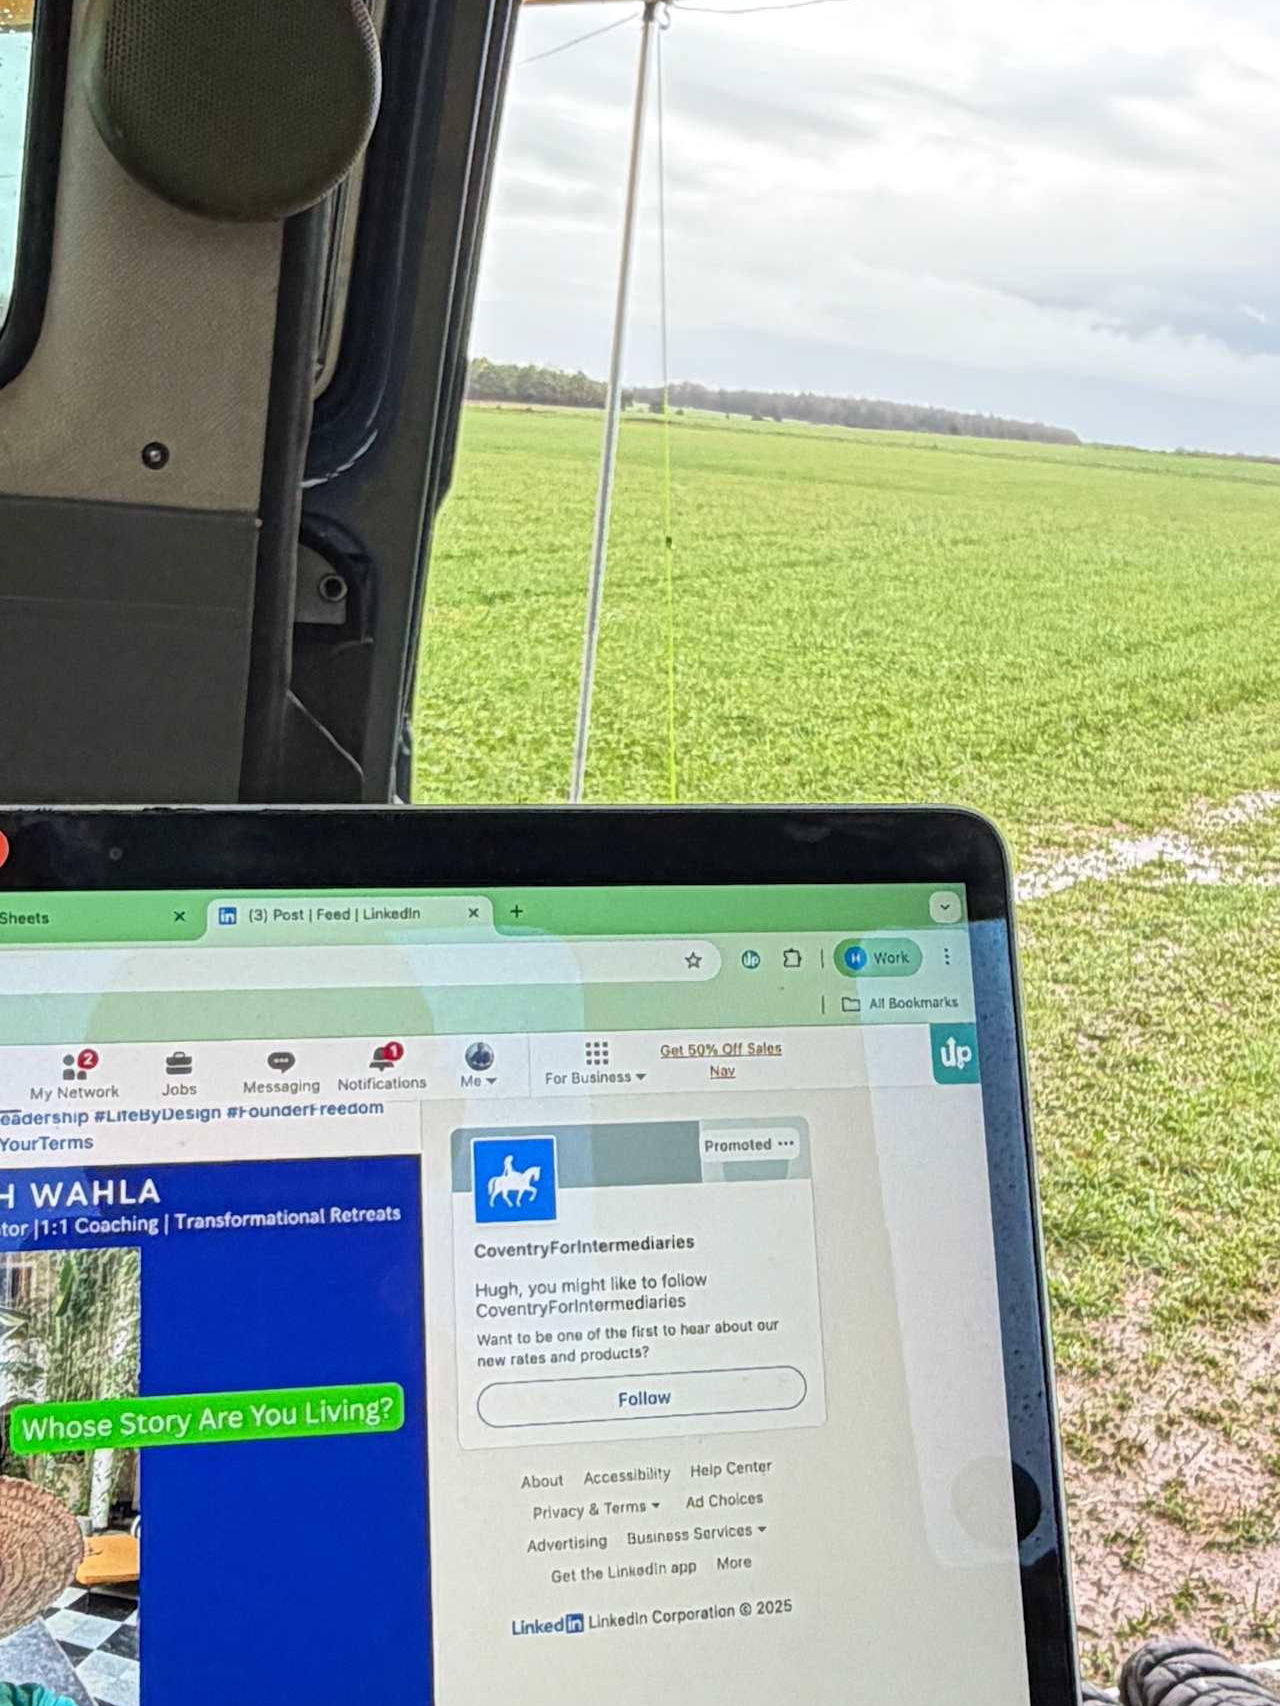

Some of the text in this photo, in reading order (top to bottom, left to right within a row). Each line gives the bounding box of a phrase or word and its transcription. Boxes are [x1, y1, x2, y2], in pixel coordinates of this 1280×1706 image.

[249, 906, 421, 923] (3) Post Feed LinkedIn
[874, 949, 910, 965] Work
[869, 994, 959, 1010] All Bookmarks
[660, 1041, 783, 1059] Get 50% Off Sales
[460, 1074, 483, 1088] Me
[545, 1070, 632, 1085] For Business
[710, 1065, 736, 1079] Nav
[30, 1083, 120, 1102] My Network
[162, 1082, 197, 1098] Jobs
[243, 1079, 321, 1098] Messaging
[338, 1076, 427, 1092] Notifications
[704, 1137, 772, 1154] Promoted
[31, 1177, 161, 1208] WAHLA
[75, 1214, 159, 1236] Coaching
[175, 1207, 326, 1231] Transformational
[330, 1205, 402, 1224] Retreats
[474, 1234, 696, 1261] CoventryForIntermediaries
[475, 1272, 708, 1301] Hugh, you might like to follow
[476, 1294, 687, 1320] CoventryForIntermediaries
[477, 1319, 780, 1347] Want to be one of the first to hear about our
[477, 1344, 650, 1368] new rates and products?
[618, 1389, 671, 1407] Follow
[22, 1395, 395, 1442] Whose Story Are You Living?
[584, 1467, 671, 1486] Accessibility
[690, 1460, 773, 1479] Help Center
[521, 1474, 564, 1489] About
[686, 1492, 764, 1510] Ad Choices
[533, 1500, 647, 1522] Privacy Terms
[527, 1534, 608, 1554] Advertising
[627, 1524, 753, 1546] Business Services
[716, 1556, 752, 1571] More
[589, 1598, 793, 1629] LinkedIn Corporation 2025
